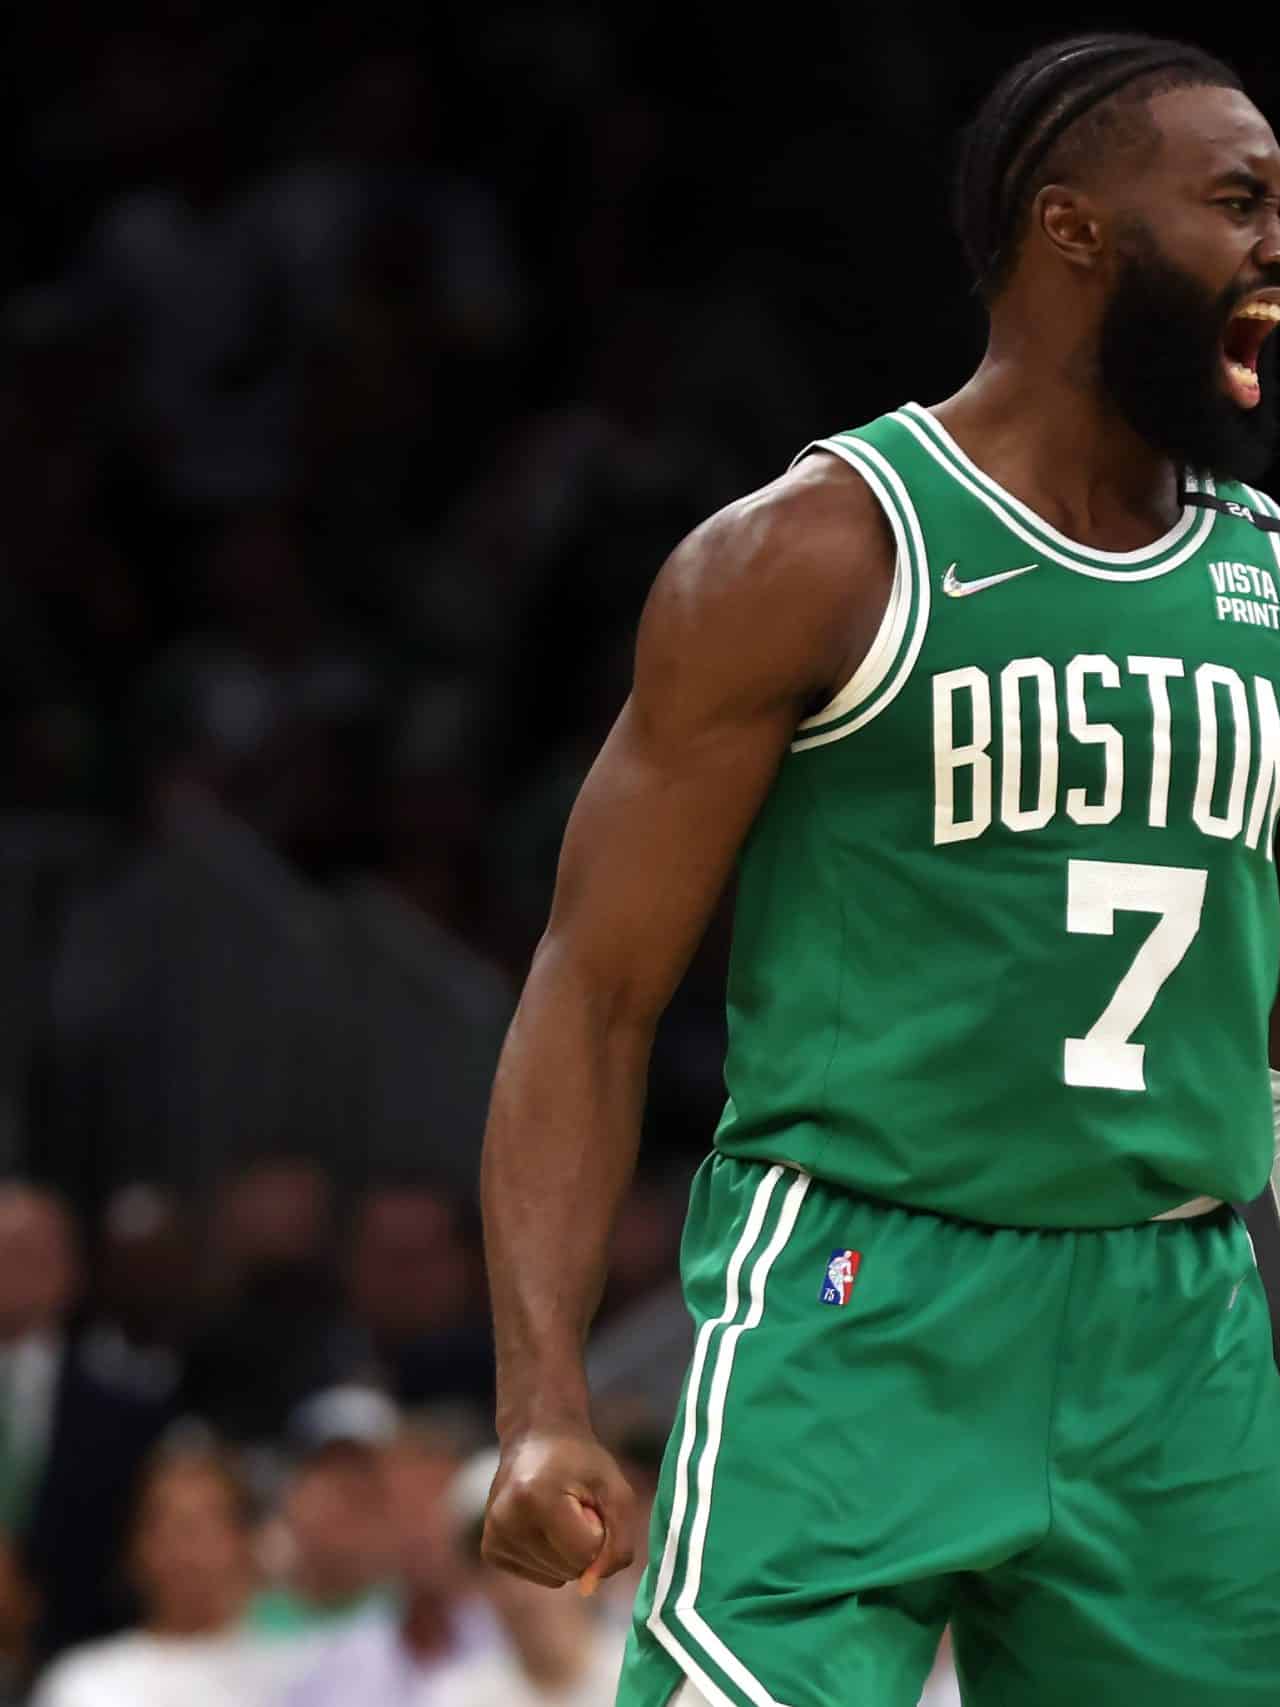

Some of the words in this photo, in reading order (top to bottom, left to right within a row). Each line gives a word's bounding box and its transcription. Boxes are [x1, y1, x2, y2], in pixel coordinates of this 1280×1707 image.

[1209, 562, 1279, 603] VISTA
[1216, 597, 1280, 630] PRINT
[1064, 860, 1207, 1091] 7
[824, 1288, 836, 1301] 75
